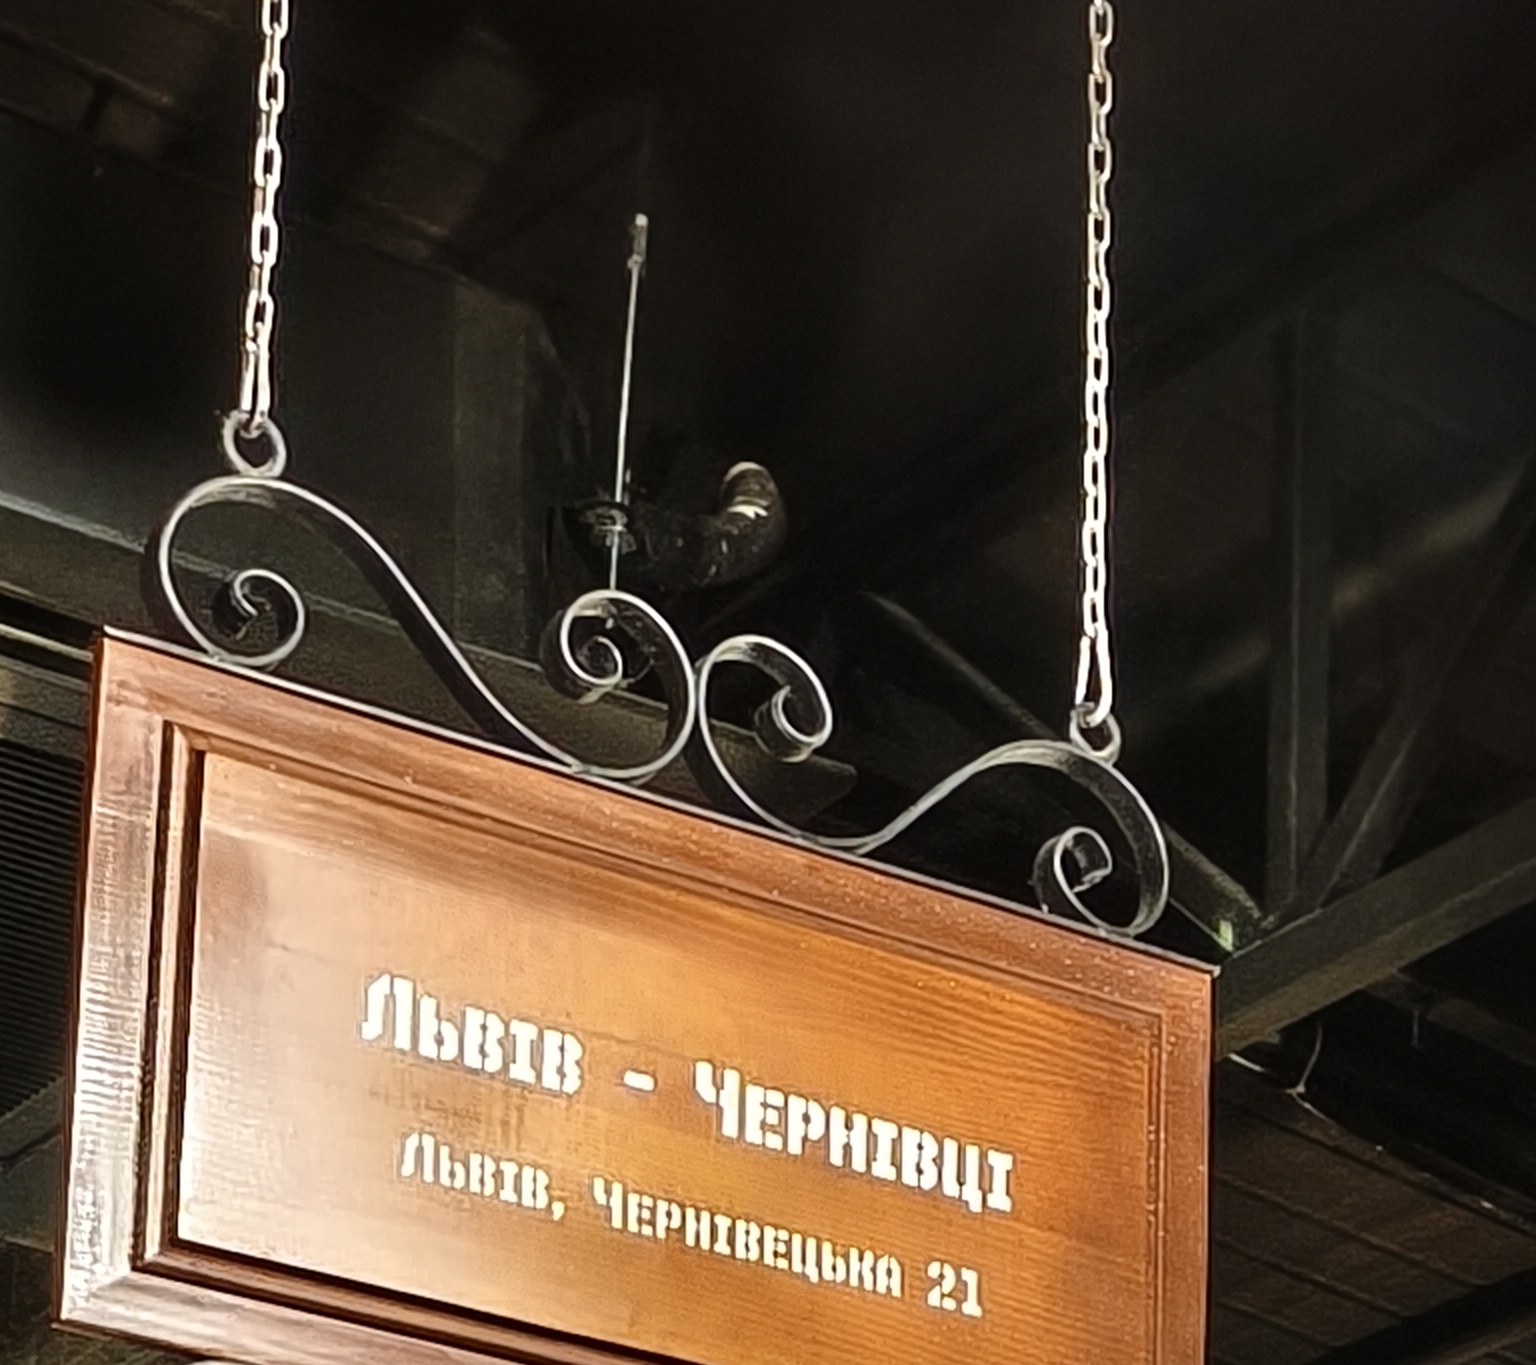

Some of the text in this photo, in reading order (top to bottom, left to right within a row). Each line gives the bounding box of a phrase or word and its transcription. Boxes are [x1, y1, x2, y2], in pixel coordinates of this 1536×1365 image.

[361, 973, 582, 1094] ЛЬВІВ
[694, 1060, 1013, 1213] ЧЕРНІВЦІ
[401, 1134, 983, 1317] ЛЬВІВ, ЧЕРНІВЕЦЬКА 21
